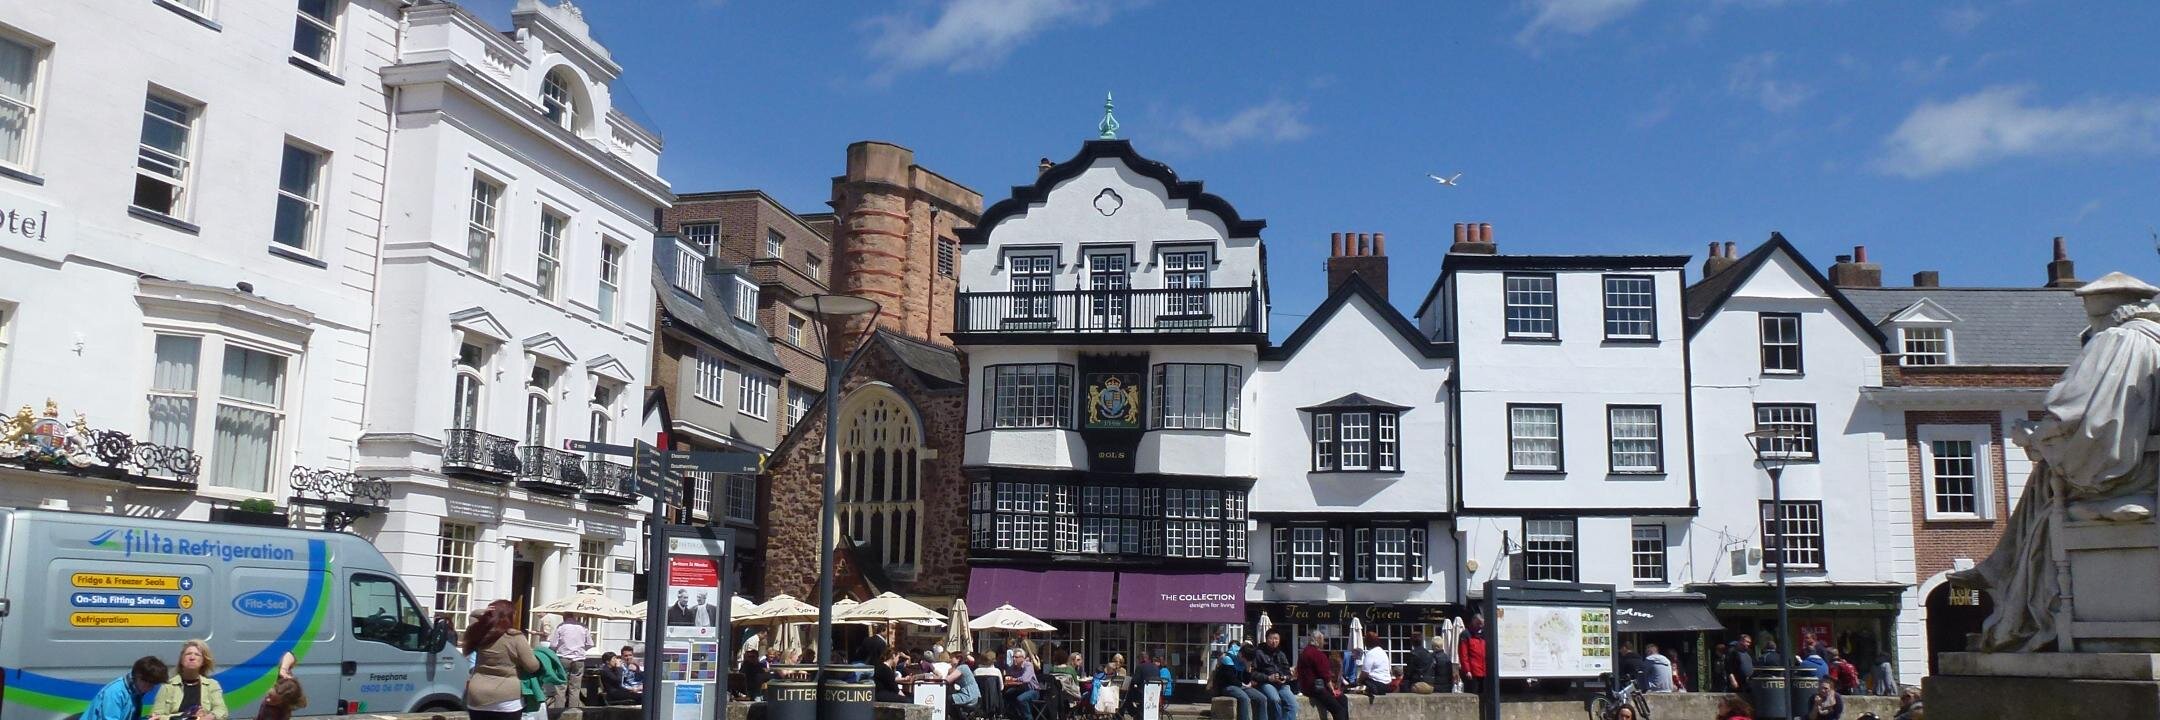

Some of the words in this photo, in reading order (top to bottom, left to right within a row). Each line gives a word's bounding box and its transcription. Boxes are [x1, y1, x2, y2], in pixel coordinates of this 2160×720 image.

[125, 529, 173, 557] filta
[179, 538, 294, 562] Refrigeration
[77, 575, 103, 585] Fridge
[114, 578, 143, 586] Freezer
[76, 595, 107, 603] On-Site
[110, 596, 135, 606] Fitting
[137, 597, 165, 605] Service
[1285, 604, 1309, 618] Tea
[1317, 611, 1331, 619] on
[1339, 602, 1357, 620] the
[1365, 604, 1400, 623] Green
[76, 615, 129, 624] Refrigeration
[369, 673, 408, 682] Freephone
[1793, 681, 1819, 689] RECYC
[825, 690, 873, 702] CYCLING
